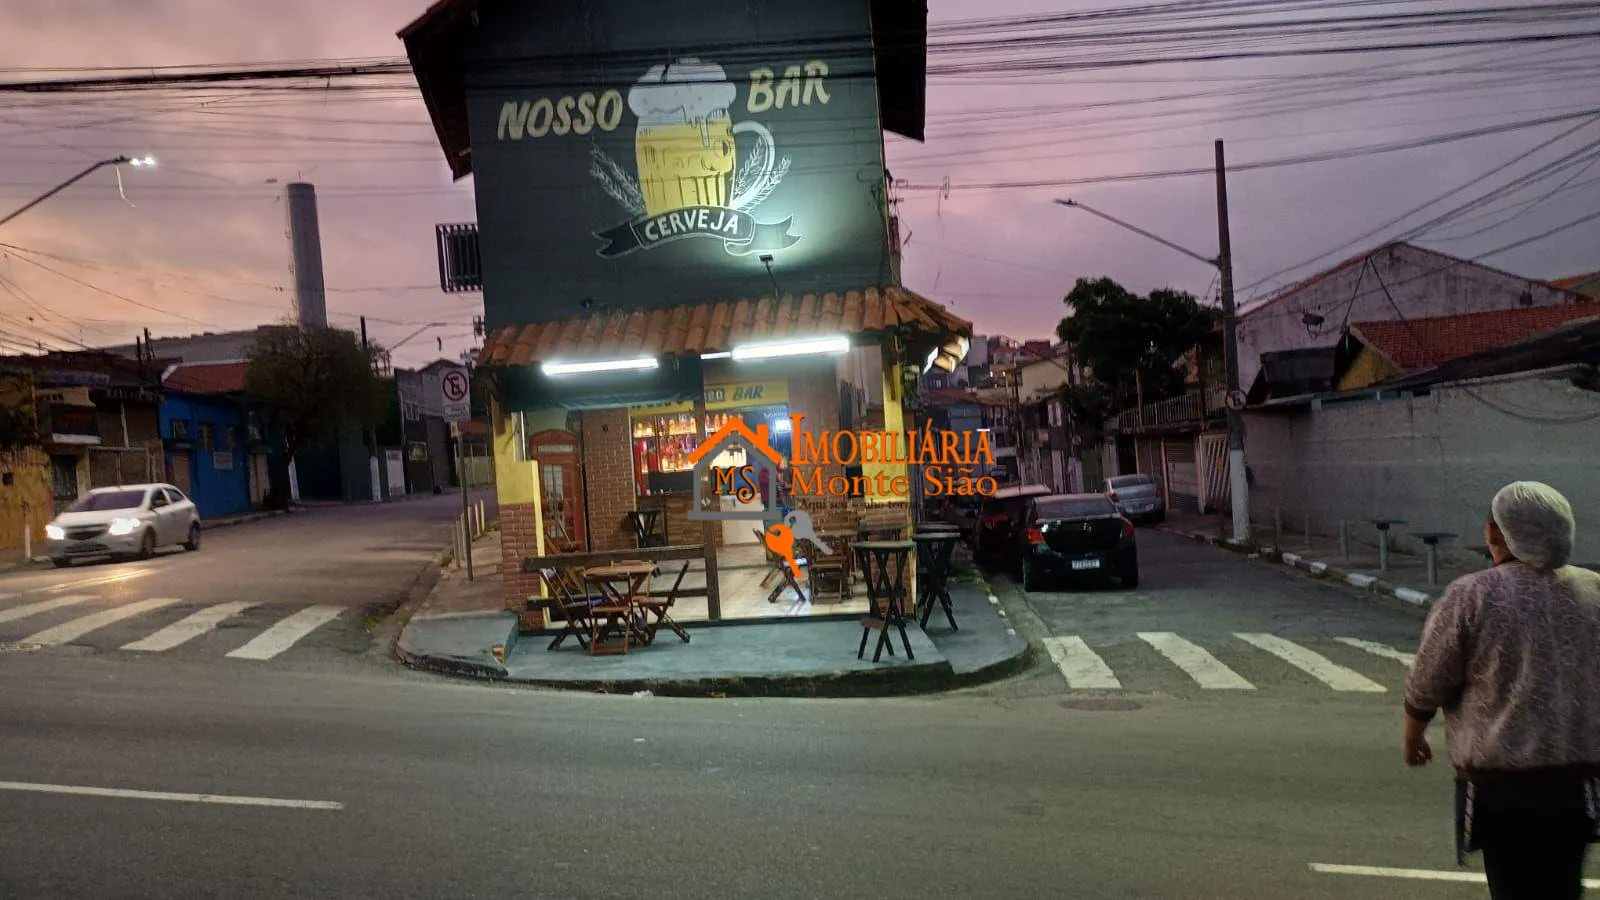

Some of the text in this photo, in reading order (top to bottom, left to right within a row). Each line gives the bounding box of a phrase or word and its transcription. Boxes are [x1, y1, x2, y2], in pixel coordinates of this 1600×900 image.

[497, 59, 831, 141] NOSSO BAR
[644, 208, 739, 243] CERVEJA
[732, 384, 764, 401] BAR
